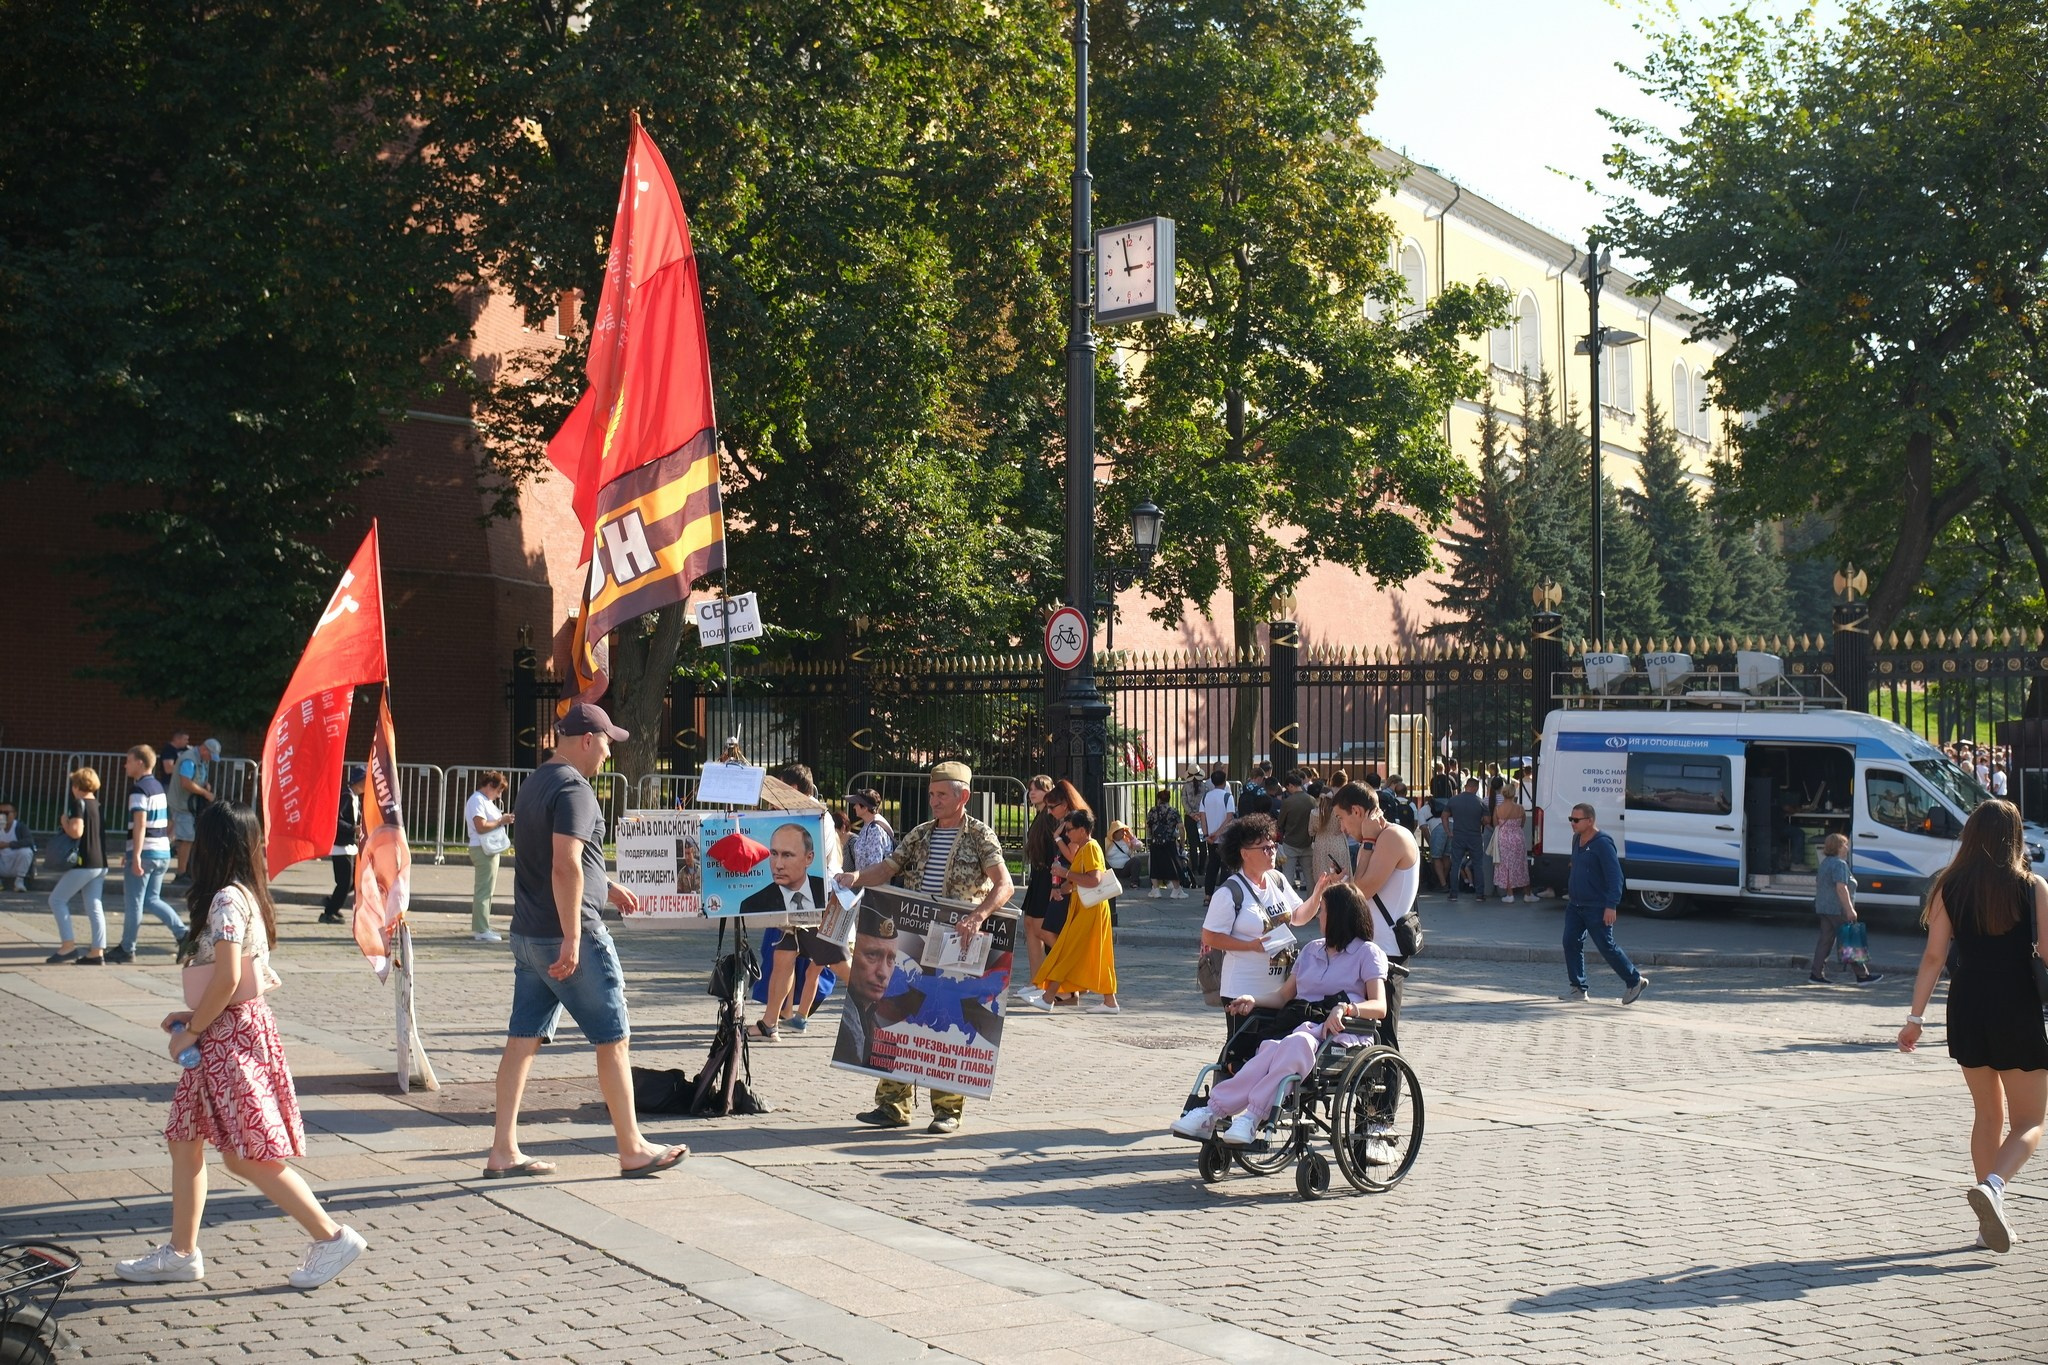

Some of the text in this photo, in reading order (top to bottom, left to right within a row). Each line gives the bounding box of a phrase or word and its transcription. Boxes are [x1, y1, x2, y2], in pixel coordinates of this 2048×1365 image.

[1126, 239, 1133, 247] 12
[700, 597, 749, 620] СБОР
[702, 622, 755, 639] ПОДИСЕЙ
[1650, 739, 1709, 748] ОПОВЕЩЕНИЯ
[647, 821, 652, 836] В
[653, 820, 698, 836] ОПАСНОСТИ!
[624, 849, 669, 859] ПОДДЕРЖИВАЕМ
[619, 870, 675, 886] КУРС ПРЕЗИДЕНТА
[638, 895, 657, 914] ЩИТЕ
[660, 895, 700, 912] ОТЕЧЕСТВА!
[900, 901, 1007, 934] ИДЕТ ВНА
[873, 1027, 994, 1061] ТОЛЬКО ЧРЕЗВЫЧАЙНЫЕ
[872, 1041, 994, 1075] ПОЛНОМОЧИЯ ДЛЯ ГЛАВЫ
[869, 1056, 991, 1088] ГОСУДАРСТВА СПАСУТ СТРАНУ!
